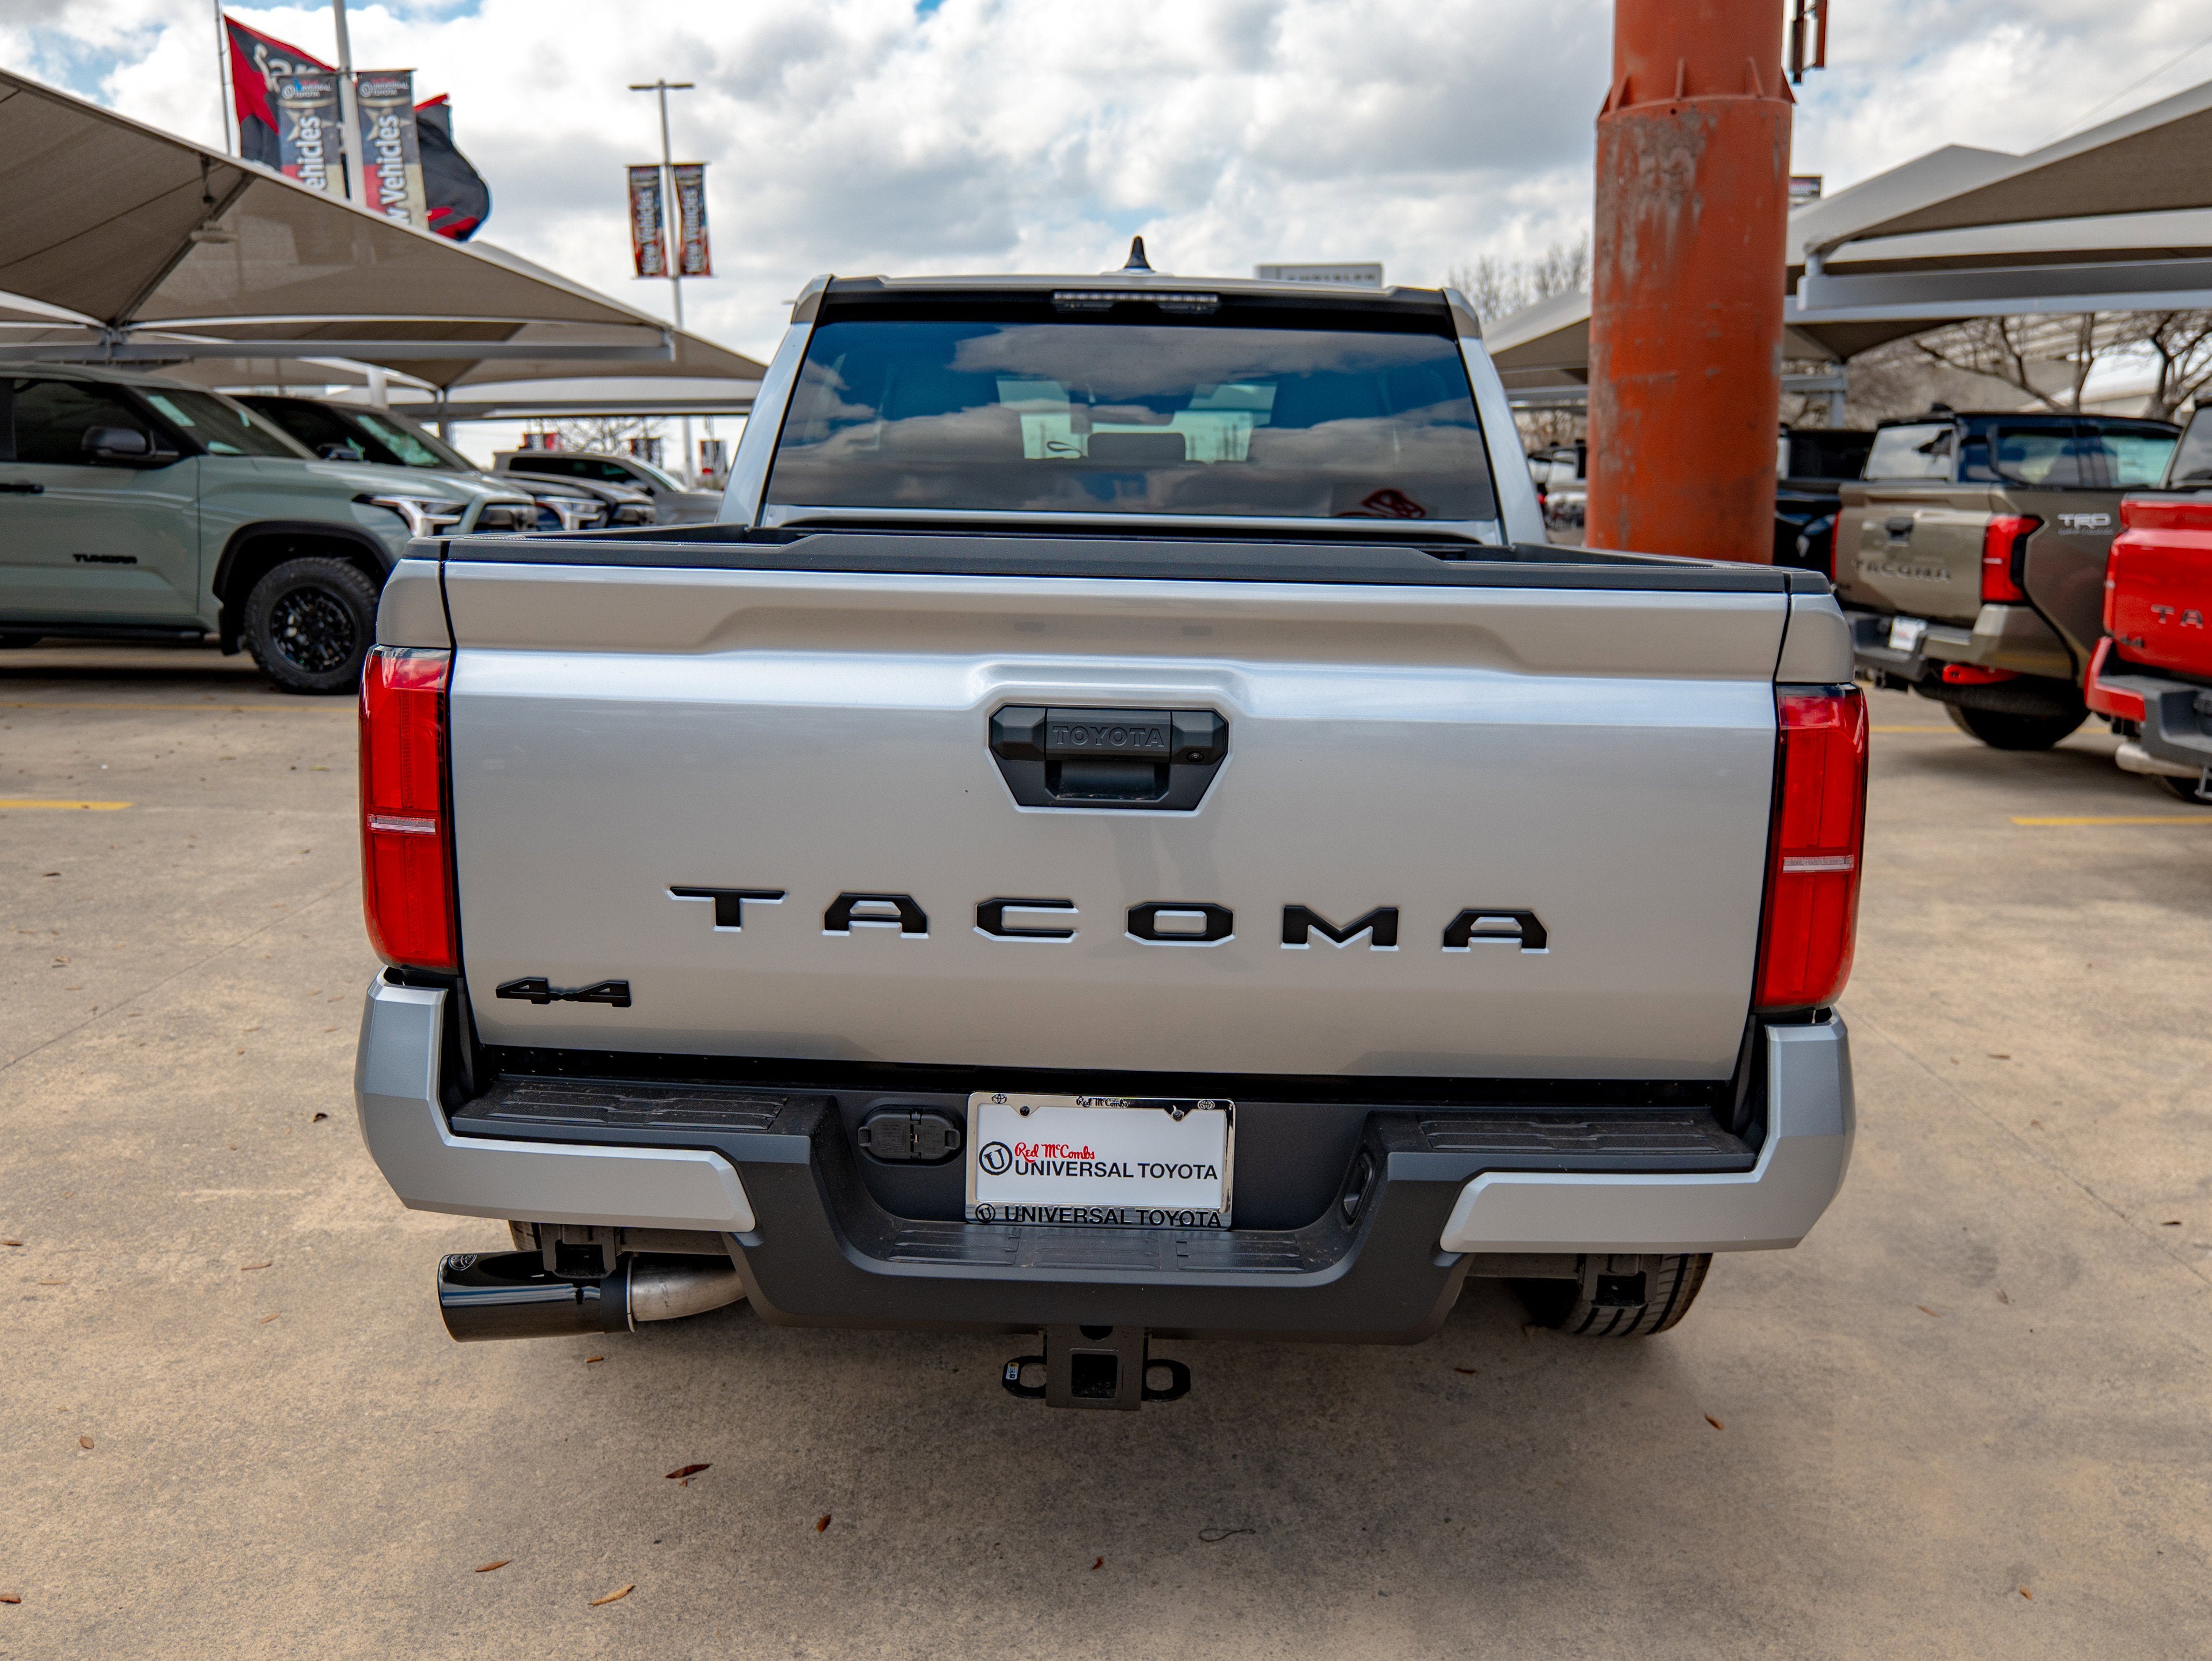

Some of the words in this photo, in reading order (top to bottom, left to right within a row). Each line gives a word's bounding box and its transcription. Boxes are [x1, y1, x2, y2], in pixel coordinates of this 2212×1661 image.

[374, 115, 408, 205] Vehicles
[636, 189, 656, 243] Vehicles
[641, 243, 661, 274] New
[685, 241, 702, 273] New
[2057, 513, 2111, 529] TRD
[73, 553, 138, 564] TUNDRA
[1052, 725, 1165, 748] TOYOTA
[665, 885, 1550, 954] TACOMA
[1076, 1095, 1092, 1108] Red
[1093, 1095, 1129, 1108] McCombs
[1014, 1142, 1039, 1163] Red
[1041, 1143, 1095, 1160] McCombs
[1015, 1159, 1134, 1178] UNIVERSAL
[1137, 1163, 1218, 1180] TOYOTA
[1004, 1205, 1132, 1225] UNIVERSAL
[1135, 1208, 1222, 1228] TOYOTA
